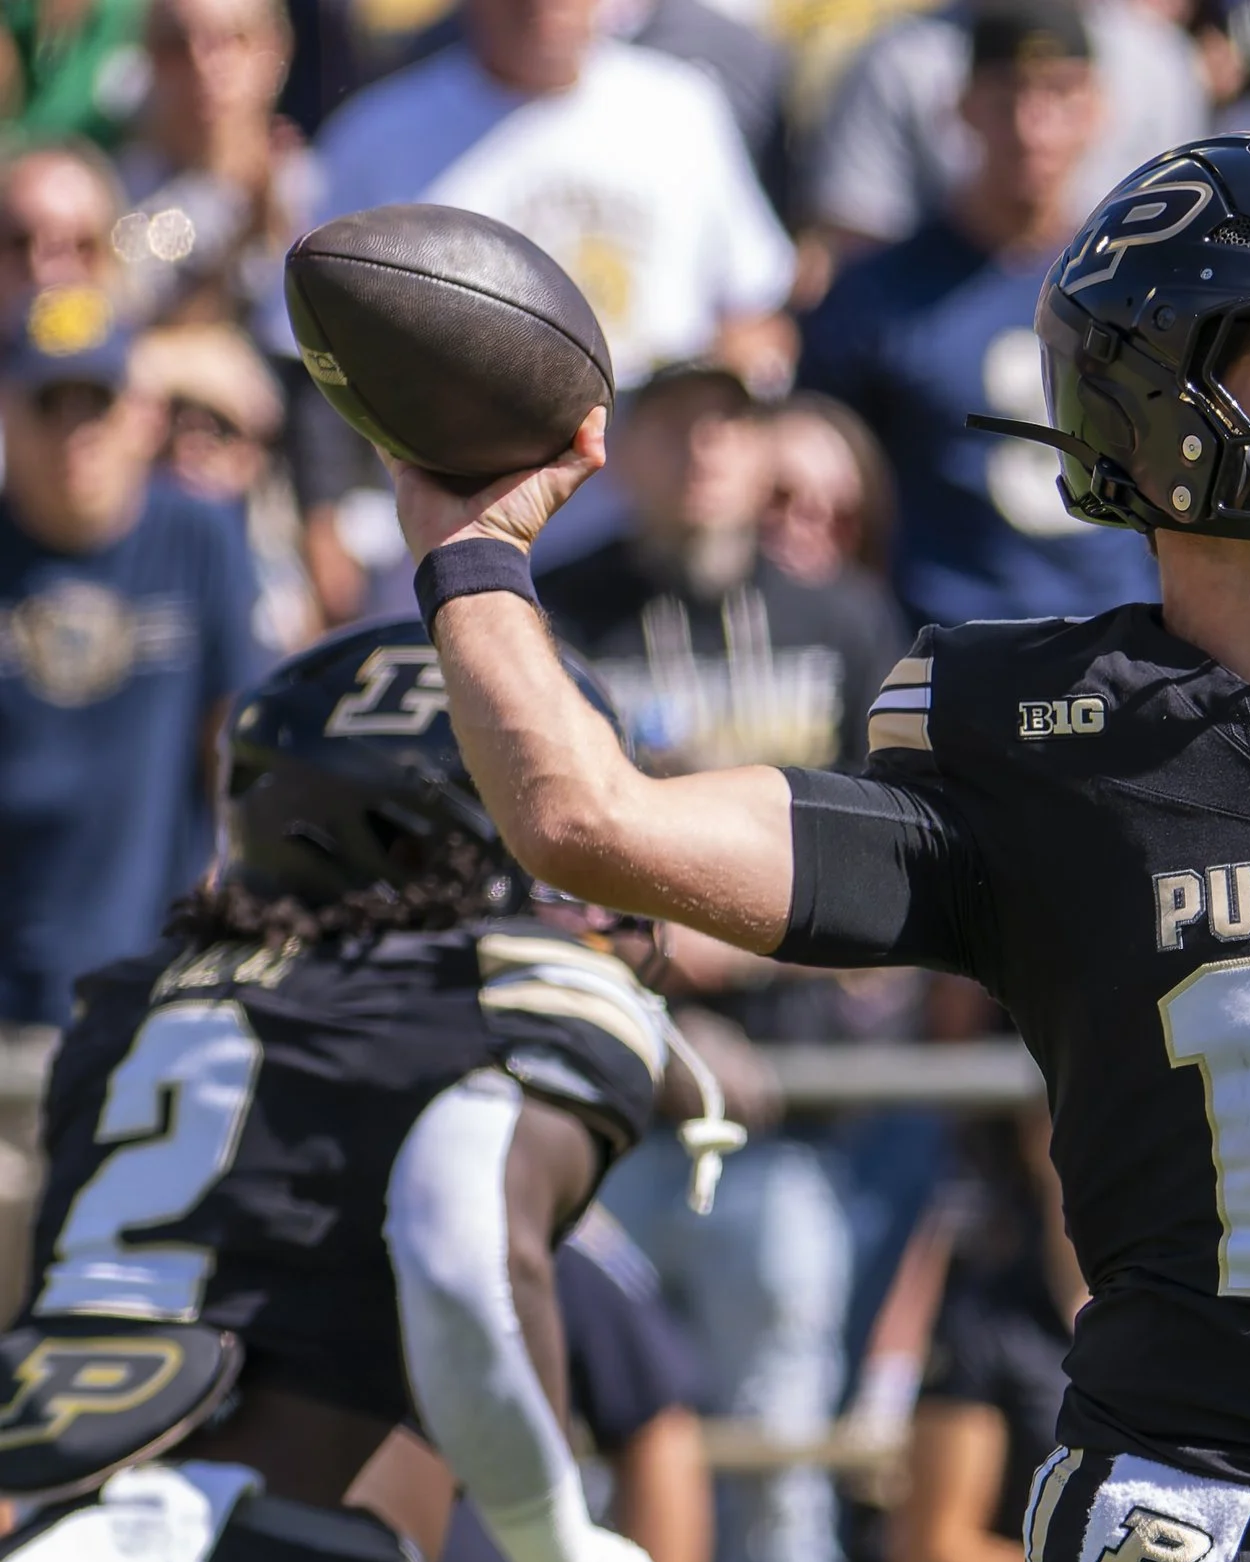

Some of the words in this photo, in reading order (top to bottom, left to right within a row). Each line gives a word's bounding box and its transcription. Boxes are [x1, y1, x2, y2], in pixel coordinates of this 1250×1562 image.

[1059, 180, 1214, 296] P
[32, 999, 264, 1323] 2
[0, 1336, 183, 1446] P
